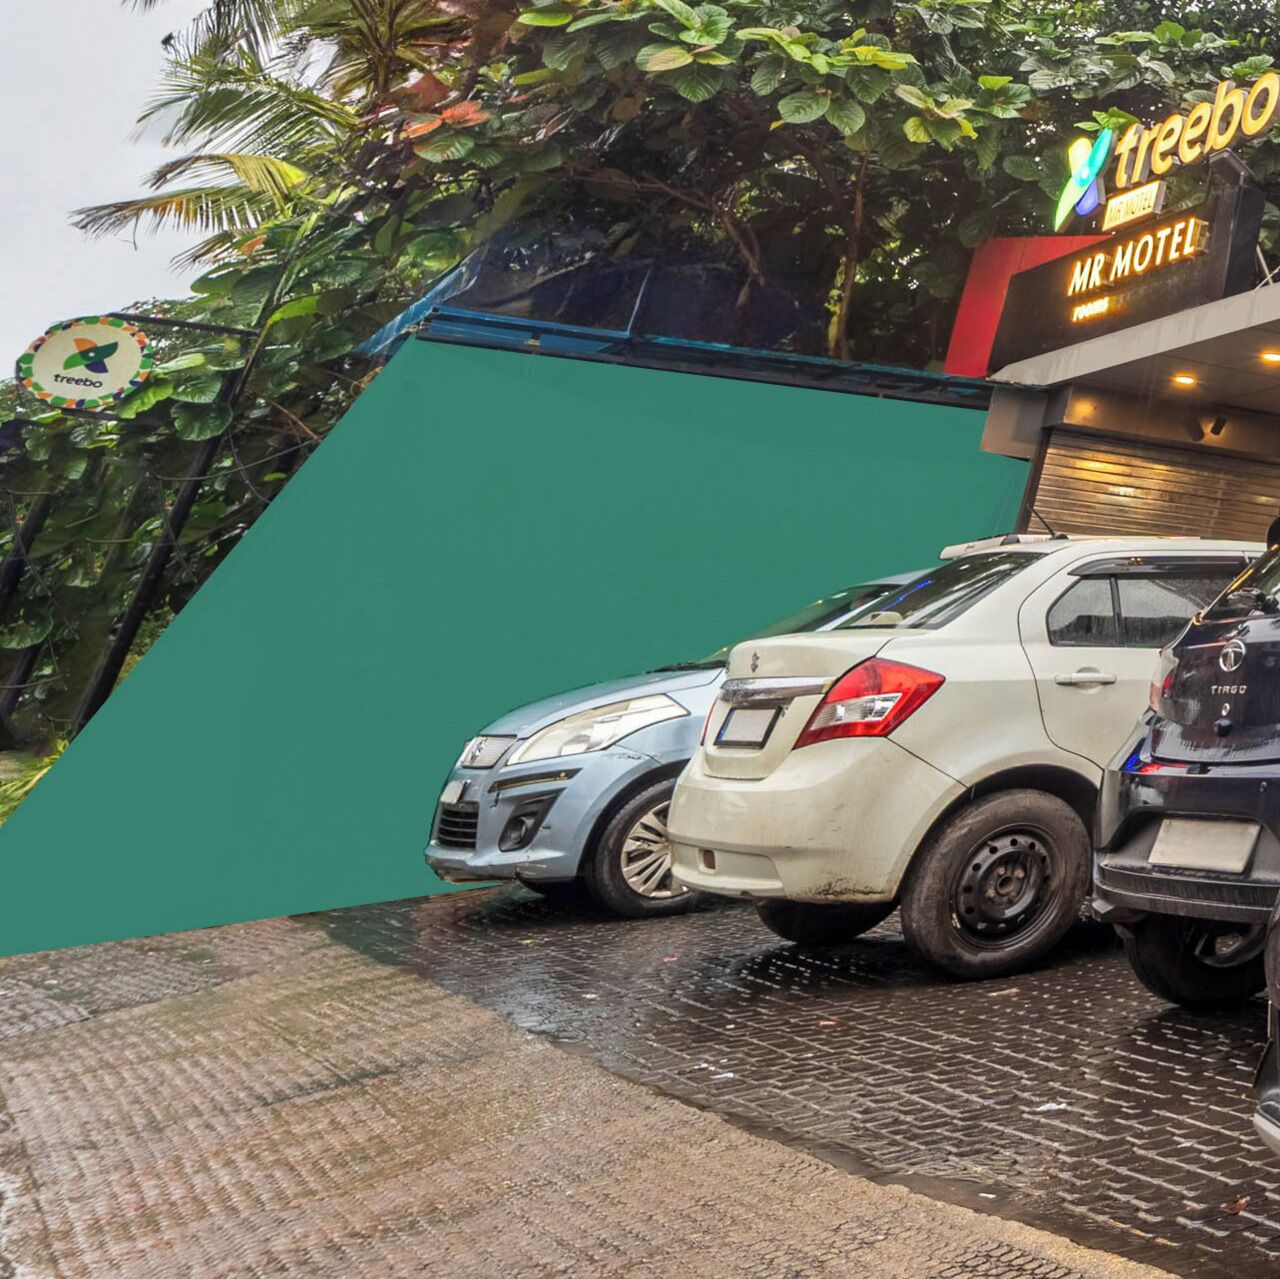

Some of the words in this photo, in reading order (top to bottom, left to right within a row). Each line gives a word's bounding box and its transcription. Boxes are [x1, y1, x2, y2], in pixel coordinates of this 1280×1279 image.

[1067, 253, 1105, 296] MR
[1109, 218, 1196, 281] MOTEL
[53, 373, 103, 388] treebo
[1211, 685, 1247, 695] TIAGO
